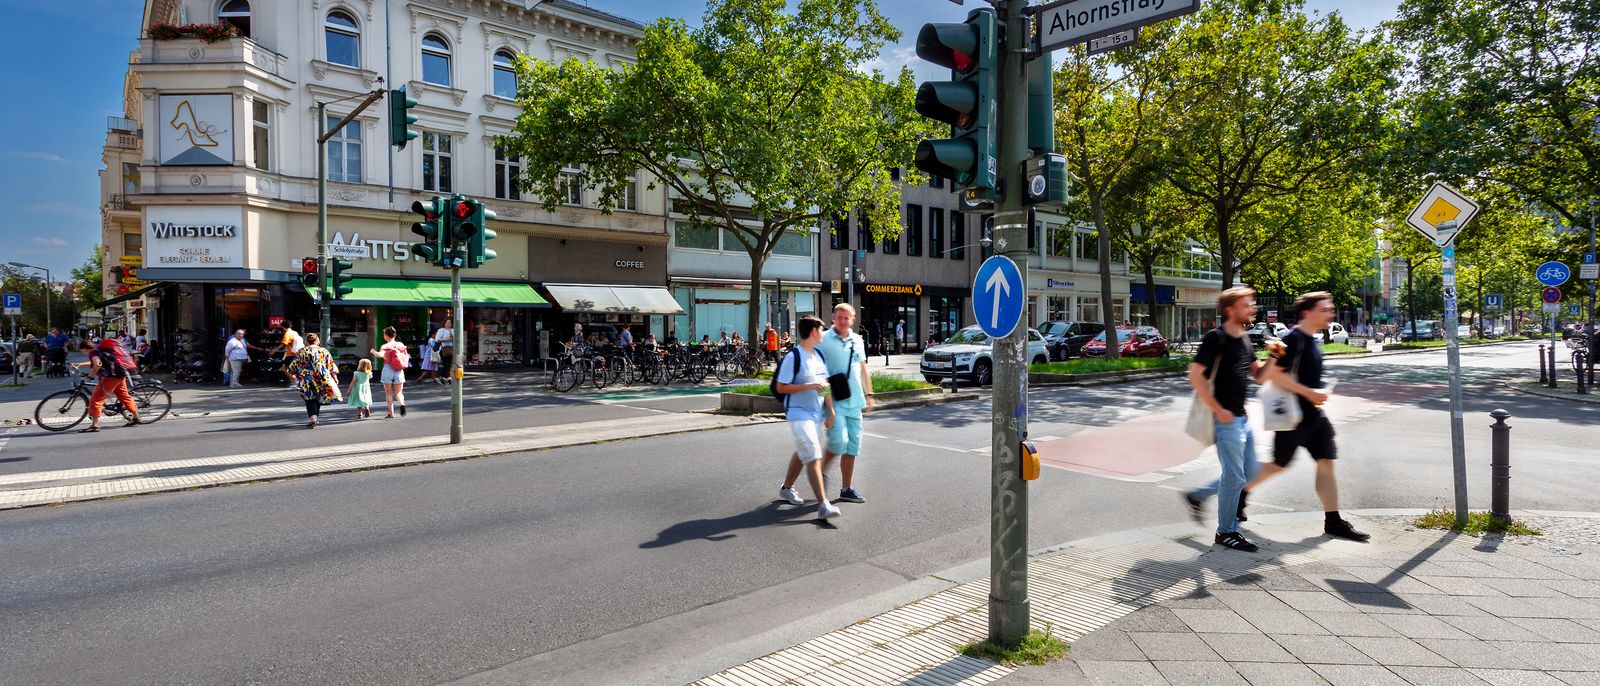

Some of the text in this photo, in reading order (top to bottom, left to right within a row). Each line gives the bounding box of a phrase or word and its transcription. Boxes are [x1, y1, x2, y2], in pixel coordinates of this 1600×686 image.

[1586, 254, 1593, 263] P
[615, 260, 645, 269] COFFEE
[866, 284, 914, 294] COMMERZBANK
[7, 295, 17, 306] P
[1488, 296, 1497, 305] U
